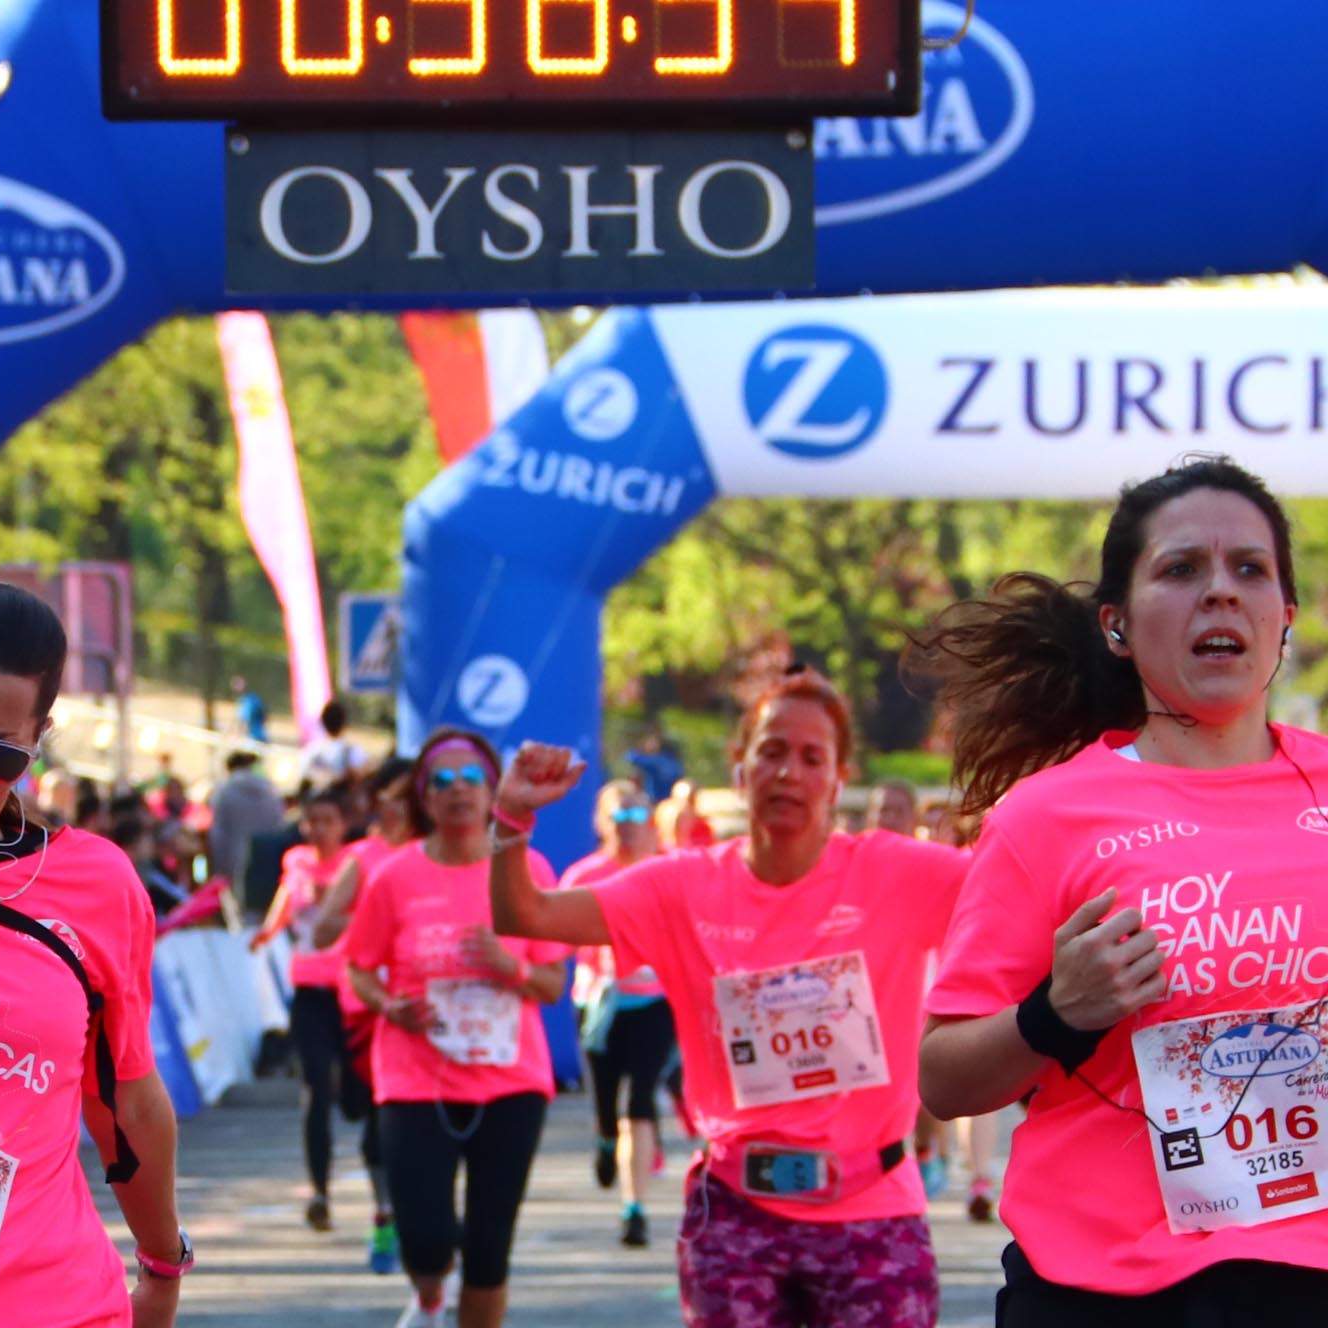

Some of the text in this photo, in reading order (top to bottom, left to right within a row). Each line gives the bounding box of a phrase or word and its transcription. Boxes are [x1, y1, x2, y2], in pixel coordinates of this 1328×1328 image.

[260, 160, 791, 264] OYSHO
[483, 430, 686, 515] ZURICH
[1096, 820, 1200, 859] OYSHO
[1140, 870, 1233, 920] HOY
[1147, 903, 1302, 958] GANAN
[1163, 957, 1216, 1000] AS
[772, 1025, 834, 1057] 016
[1210, 1046, 1312, 1070] ASTURIANA
[1226, 1105, 1319, 1151] 016
[1246, 1150, 1304, 1176] 32185
[1180, 1197, 1239, 1215] OYSHO
[1274, 1182, 1309, 1198] Santander
